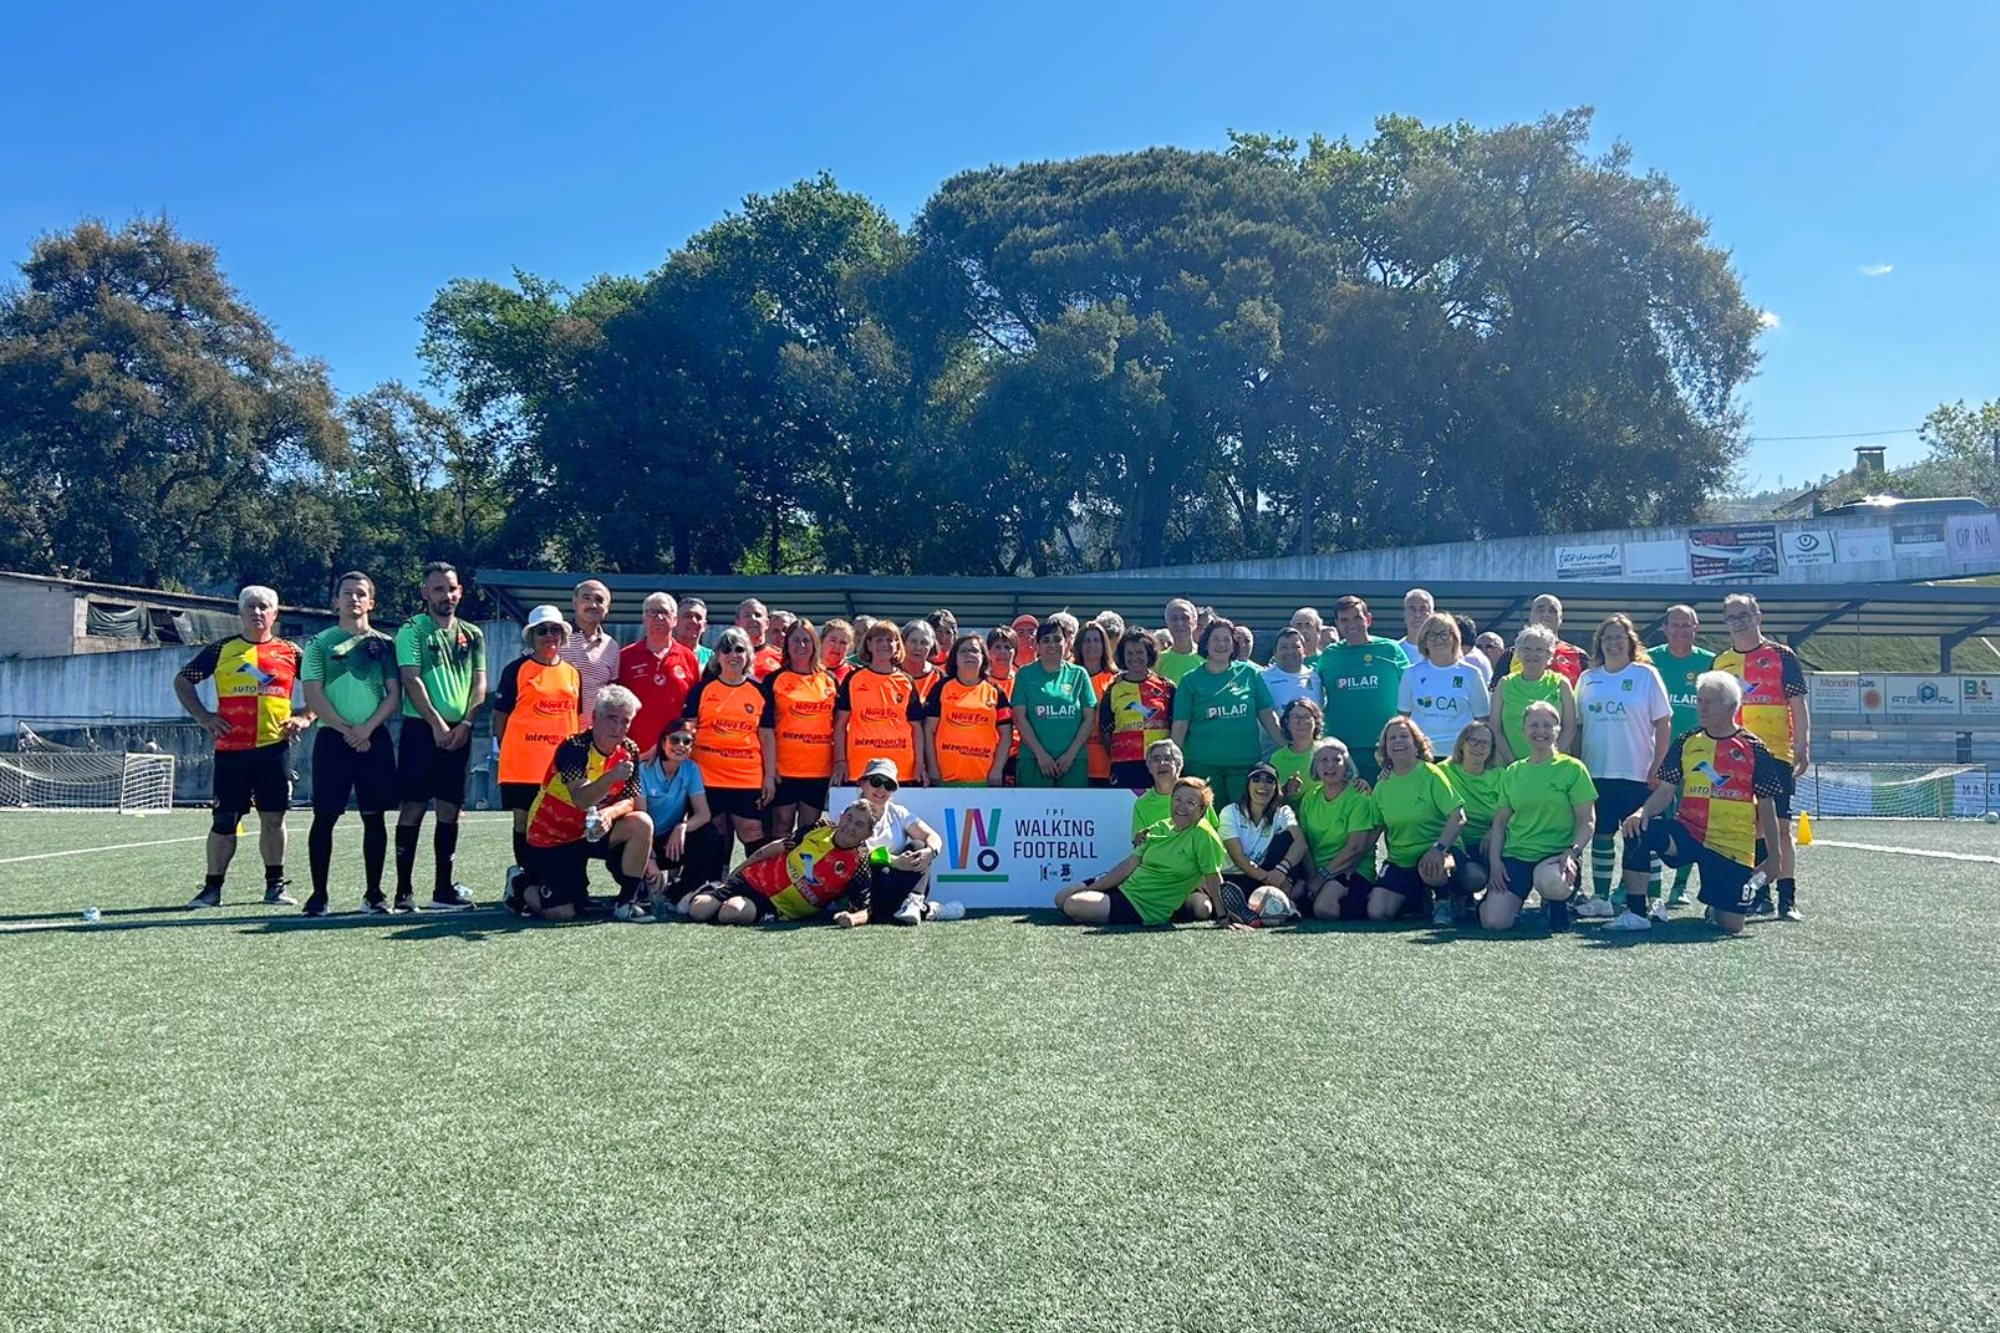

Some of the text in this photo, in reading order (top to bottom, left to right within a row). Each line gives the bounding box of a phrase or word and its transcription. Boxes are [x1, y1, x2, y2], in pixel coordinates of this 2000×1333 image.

[1338, 675, 1379, 689] PILAR
[540, 700, 562, 709] Nova
[1037, 704, 1076, 716] PILAR
[1436, 696, 1458, 711] CA
[1605, 700, 1626, 714] CA
[952, 711, 975, 721] Nova
[1208, 703, 1248, 719] PILAR
[717, 719, 738, 729] Nova
[1014, 819, 1095, 837] WALKING
[1013, 841, 1098, 858] FOOTBALL
